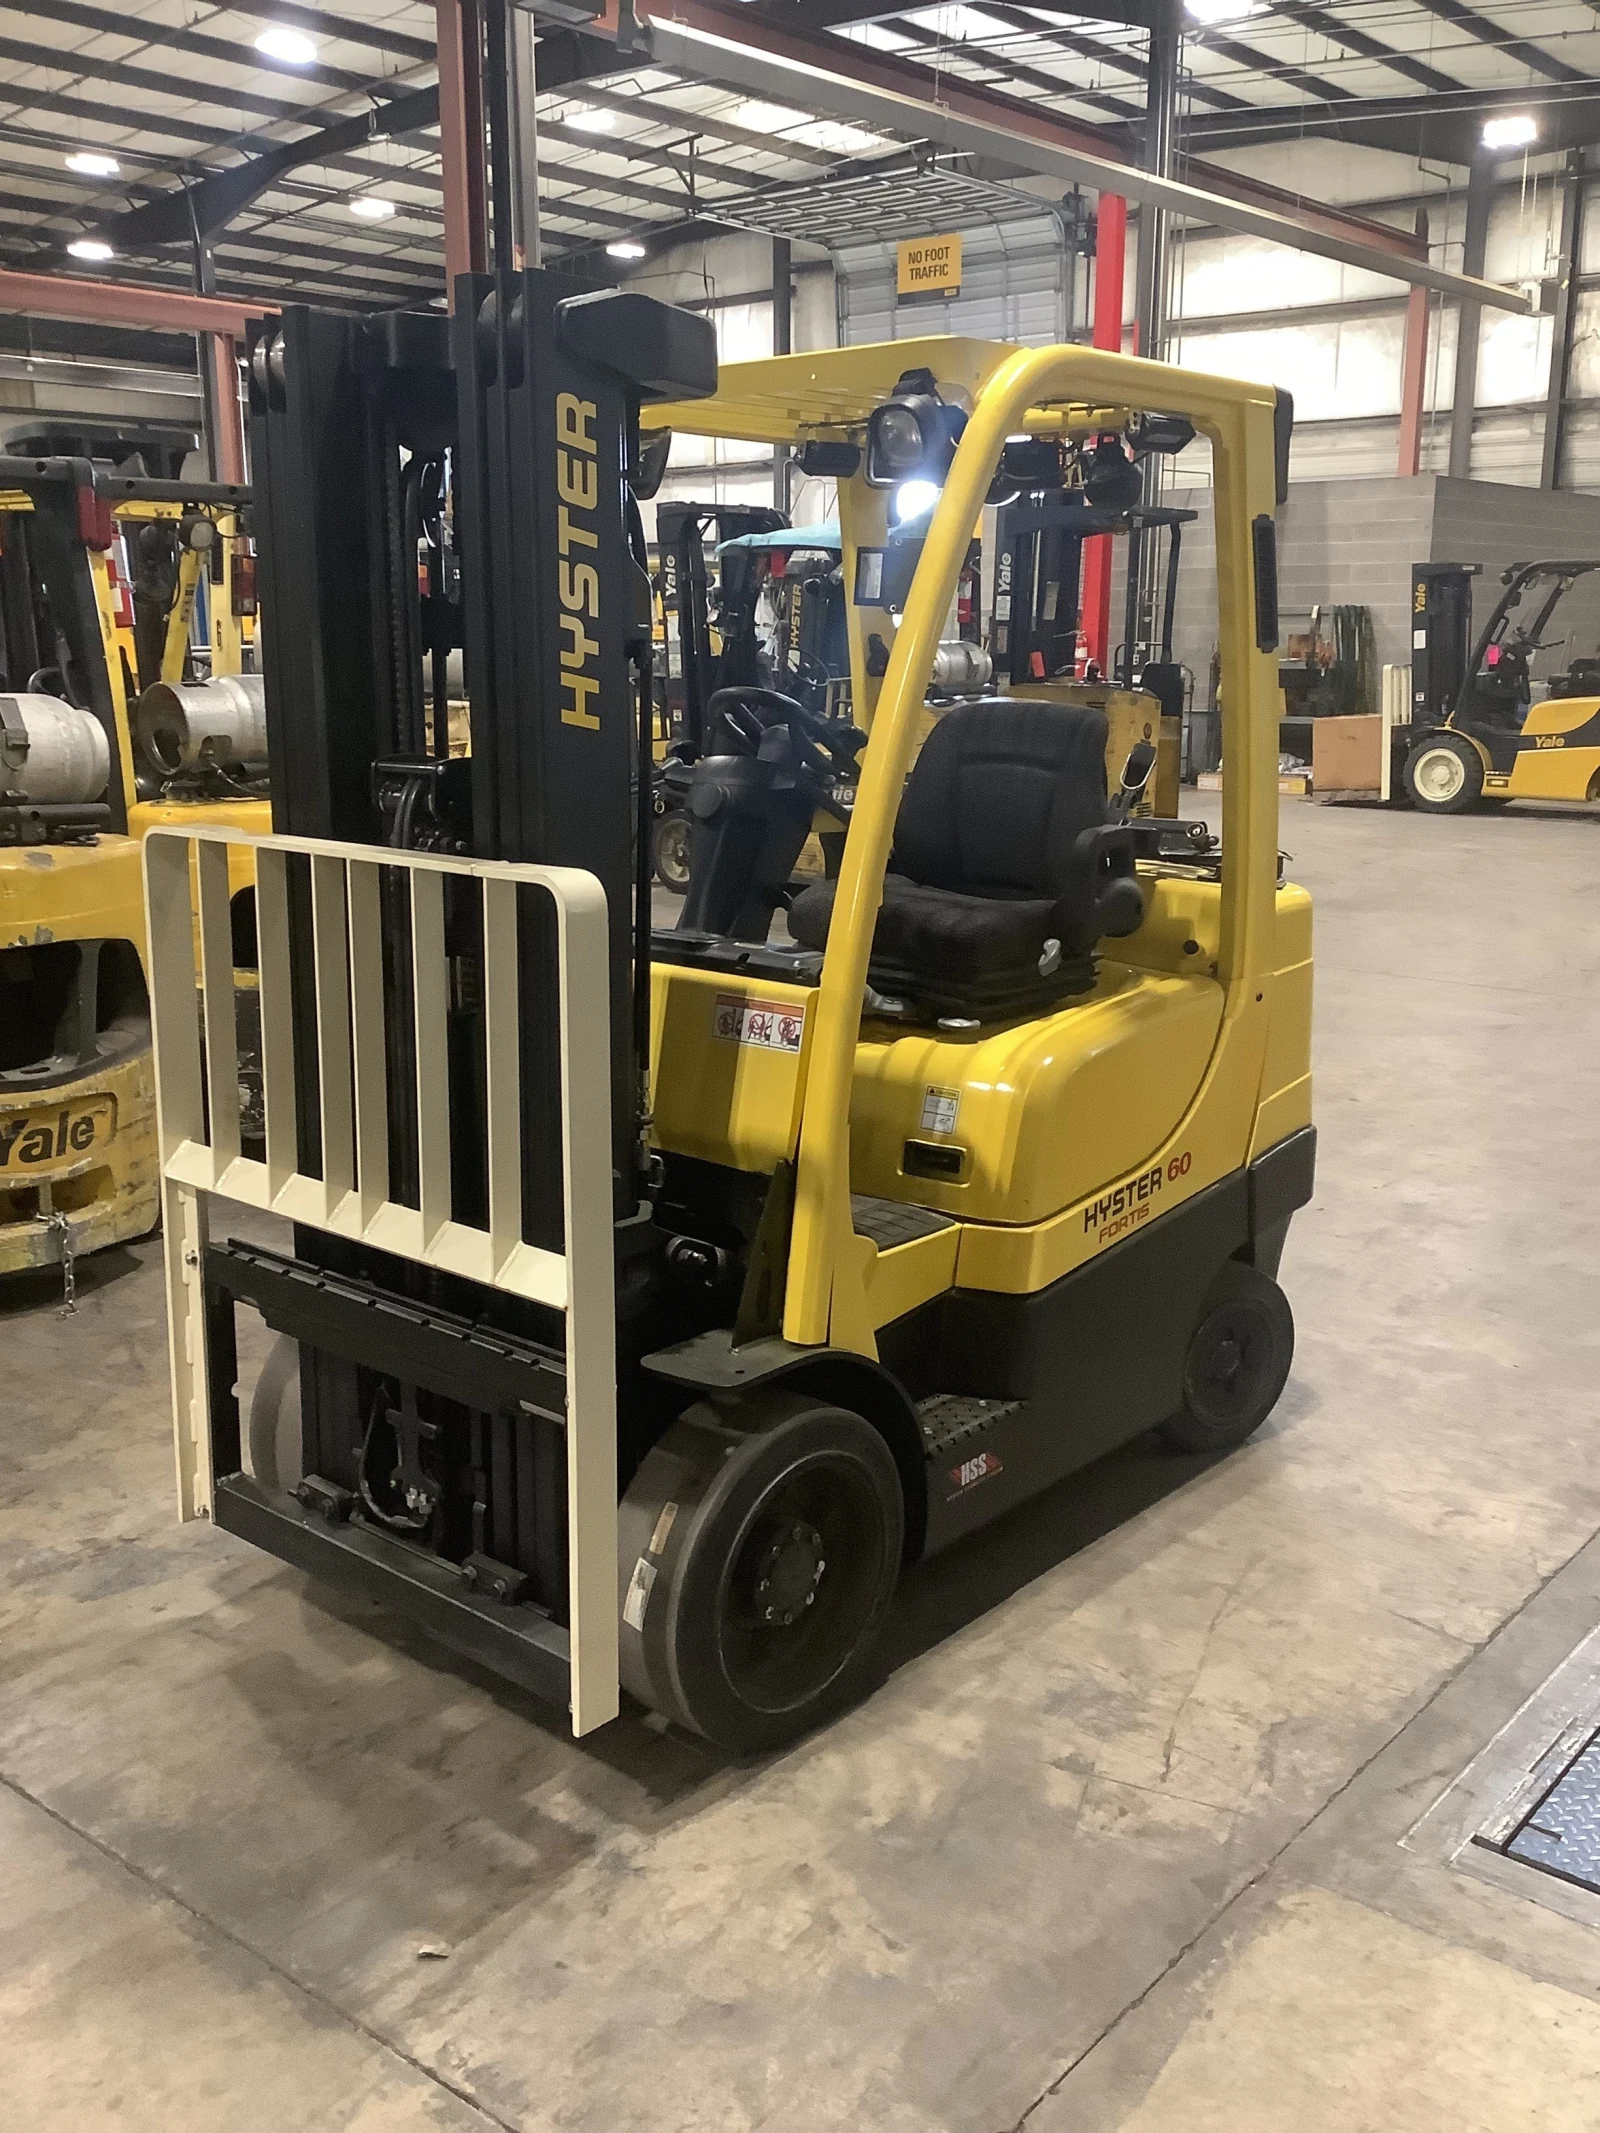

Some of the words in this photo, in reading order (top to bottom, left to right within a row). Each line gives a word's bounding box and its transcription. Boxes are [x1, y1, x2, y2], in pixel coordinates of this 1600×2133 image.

[908, 250, 922, 264] NO
[925, 246, 951, 262] FOOT
[909, 263, 949, 280] TRAFFIC
[556, 392, 600, 731] HYSTER
[664, 554, 677, 597] Yale
[998, 552, 1012, 593] Yale
[790, 584, 802, 649] HYSTER
[1414, 583, 1426, 613] Yale
[1535, 735, 1566, 748] Yale
[0, 1110, 95, 1166] Yale
[1084, 1166, 1162, 1234] HYSTER
[1167, 1151, 1192, 1182] 60
[1098, 1202, 1150, 1244] FORTIS
[960, 1453, 987, 1486] HSS
